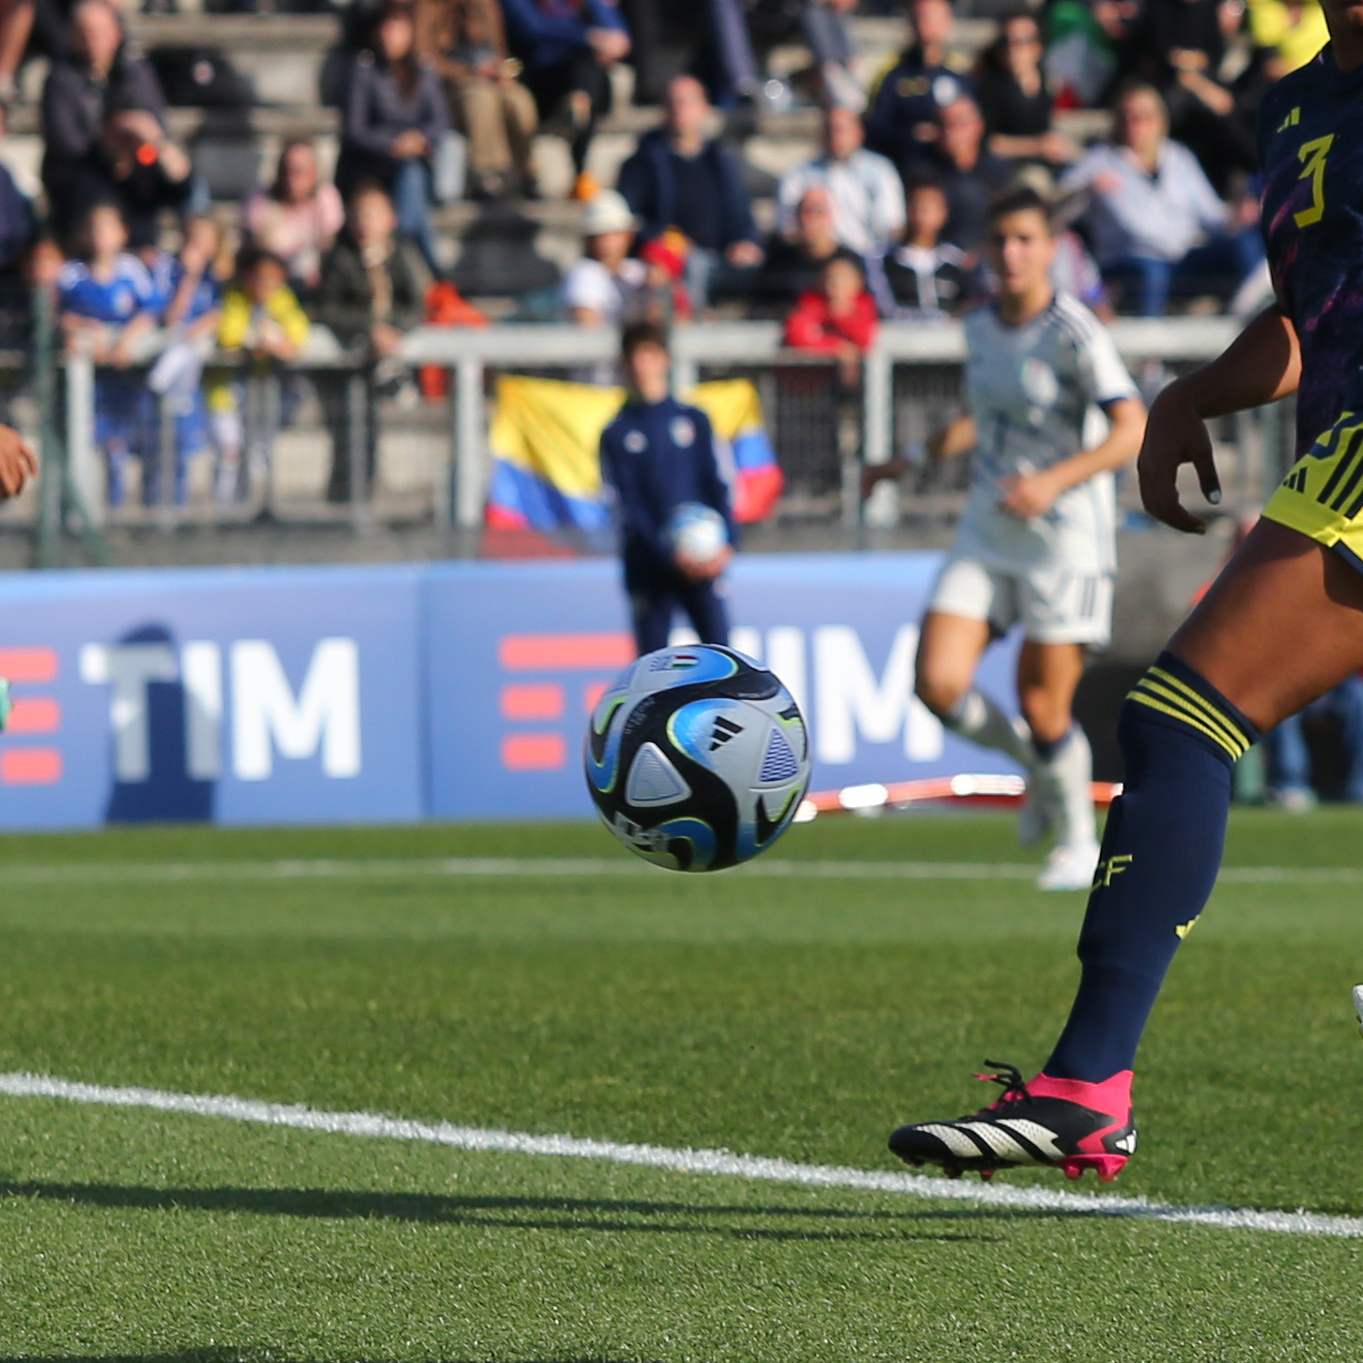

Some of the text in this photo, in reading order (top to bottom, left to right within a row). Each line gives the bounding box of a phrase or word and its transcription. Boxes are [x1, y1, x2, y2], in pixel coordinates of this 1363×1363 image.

[1293, 133, 1335, 229] 3
[79, 636, 362, 783] TIM
[666, 623, 946, 764] IM
